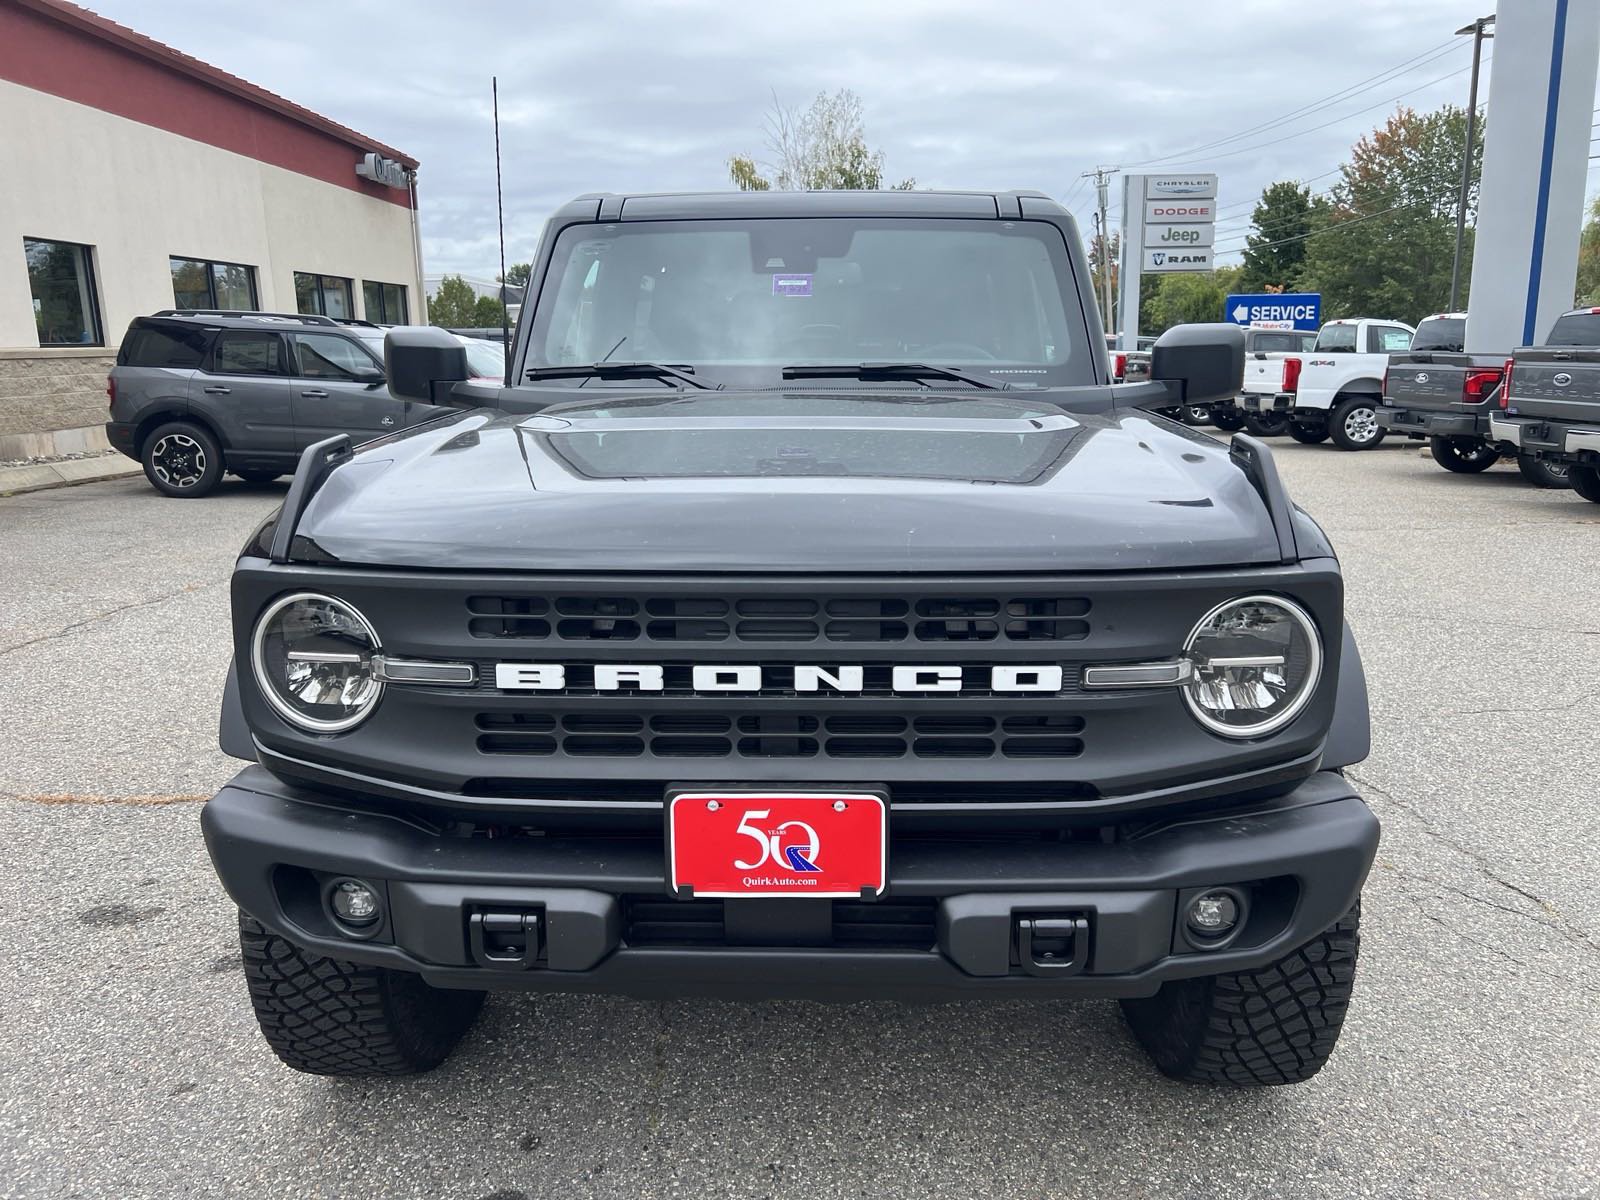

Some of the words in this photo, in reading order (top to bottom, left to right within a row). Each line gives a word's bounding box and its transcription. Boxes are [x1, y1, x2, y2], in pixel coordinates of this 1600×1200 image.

[1154, 208, 1209, 216] DODGE
[1161, 227, 1200, 244] Jeep
[1250, 305, 1316, 320] SERVICE
[495, 663, 1063, 692] BRONCO
[742, 876, 817, 887] QuirkAuto.com
